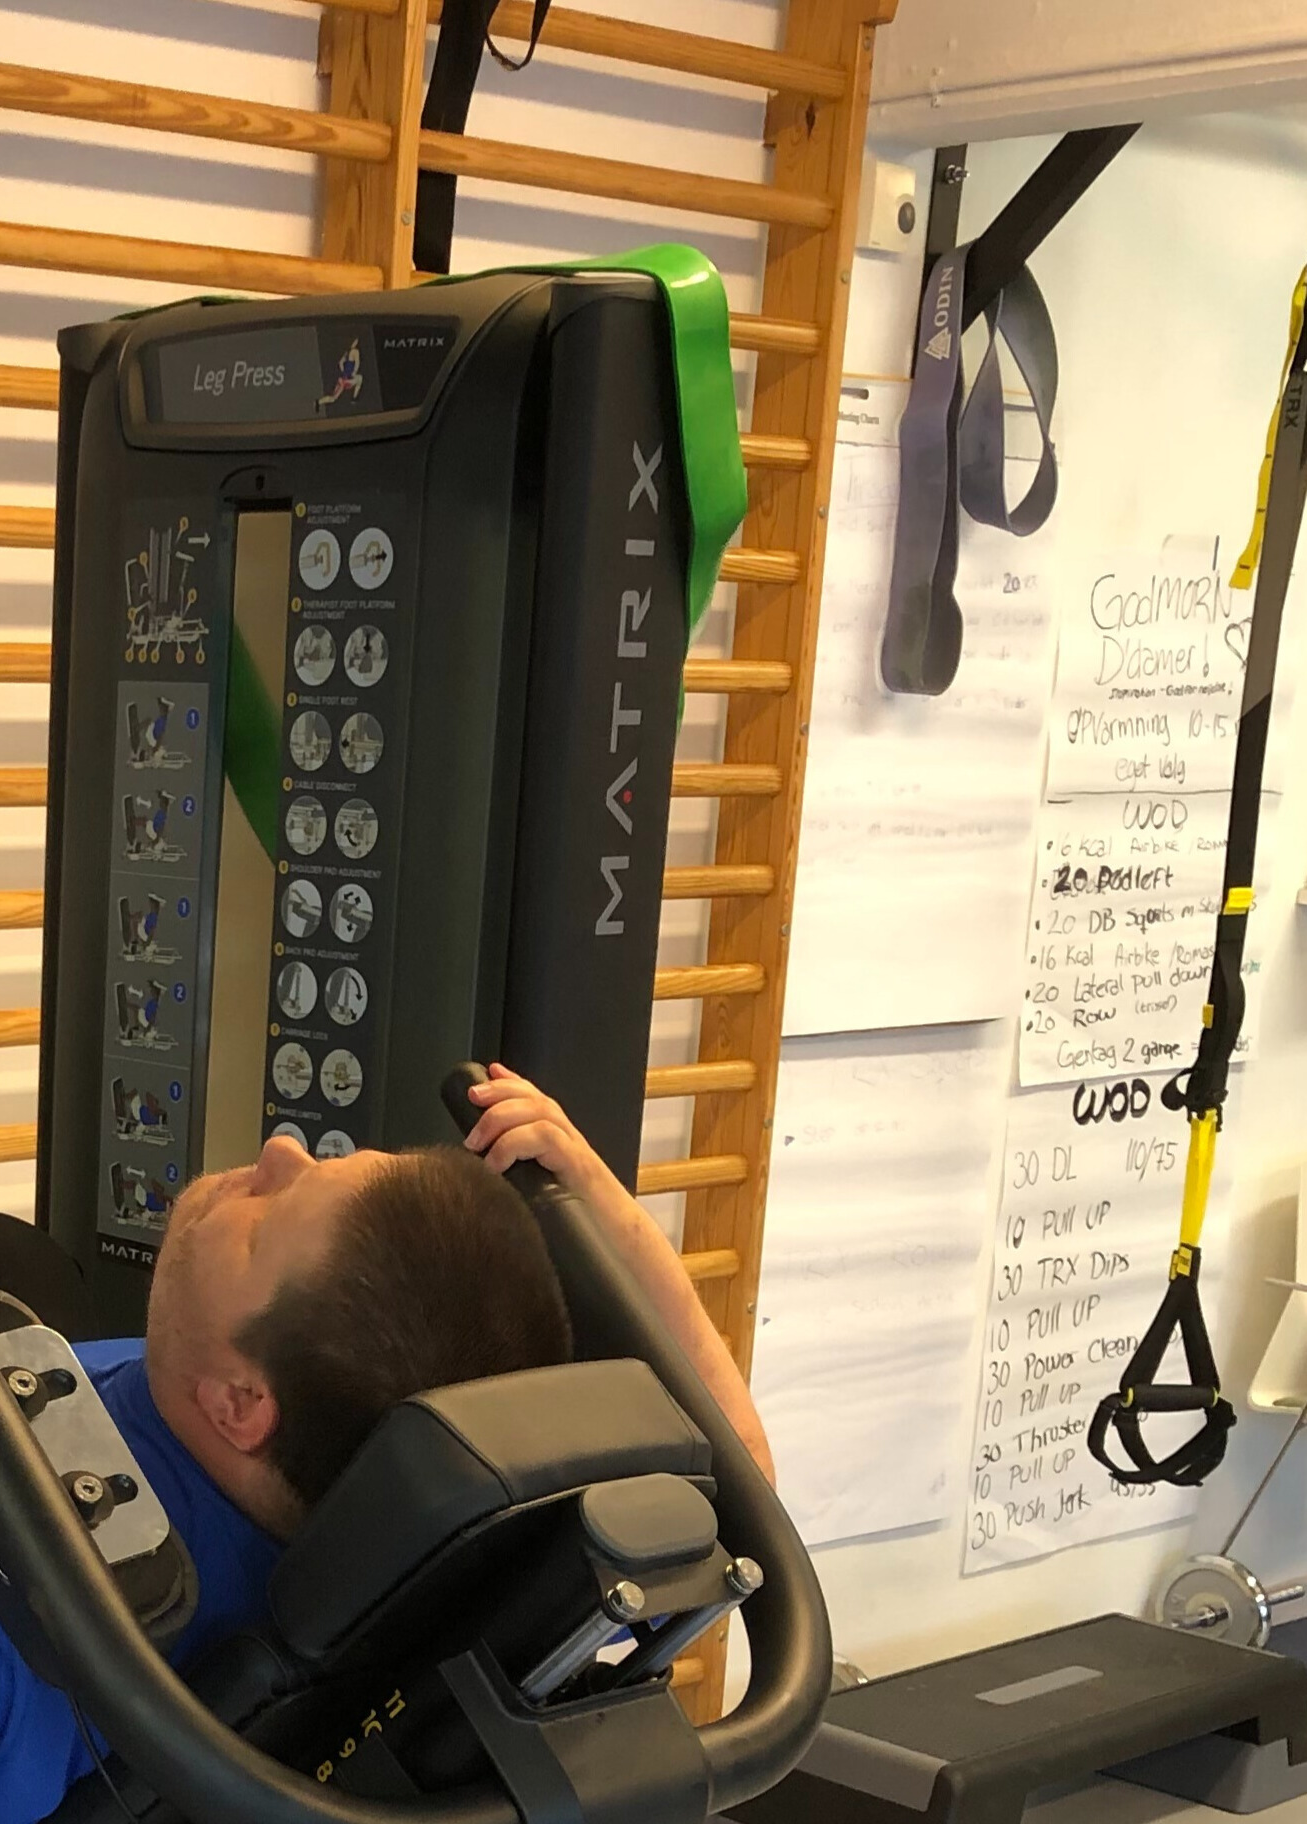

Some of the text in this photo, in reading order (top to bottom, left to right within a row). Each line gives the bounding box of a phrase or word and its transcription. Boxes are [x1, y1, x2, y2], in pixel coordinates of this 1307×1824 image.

[934, 266, 954, 327] ODIN
[383, 336, 445, 349] MATRIX
[193, 360, 286, 396] Leg Press
[594, 439, 663, 937] MATRIX
[1088, 907, 1116, 935] DB
[1038, 944, 1057, 971] 16
[1032, 981, 1060, 1004] 20
[1034, 1009, 1057, 1035] 20
[1121, 1037, 1136, 1064] 2
[1073, 1078, 1151, 1126] WOD
[1013, 1150, 1040, 1190] 30
[1051, 1144, 1077, 1182] DL
[1005, 1214, 1026, 1250] 10
[101, 1240, 154, 1264] MATR
[997, 1263, 1023, 1302] 30
[1037, 1253, 1080, 1290] TRX
[990, 1318, 1011, 1353] 10
[986, 1360, 1011, 1395] 30
[983, 1398, 1003, 1432] 10
[975, 1443, 1002, 1472] 30
[973, 1472, 992, 1505] 10
[971, 1511, 997, 1550] 30
[317, 1760, 333, 1783] 8
[385, 1688, 406, 1719] 11
